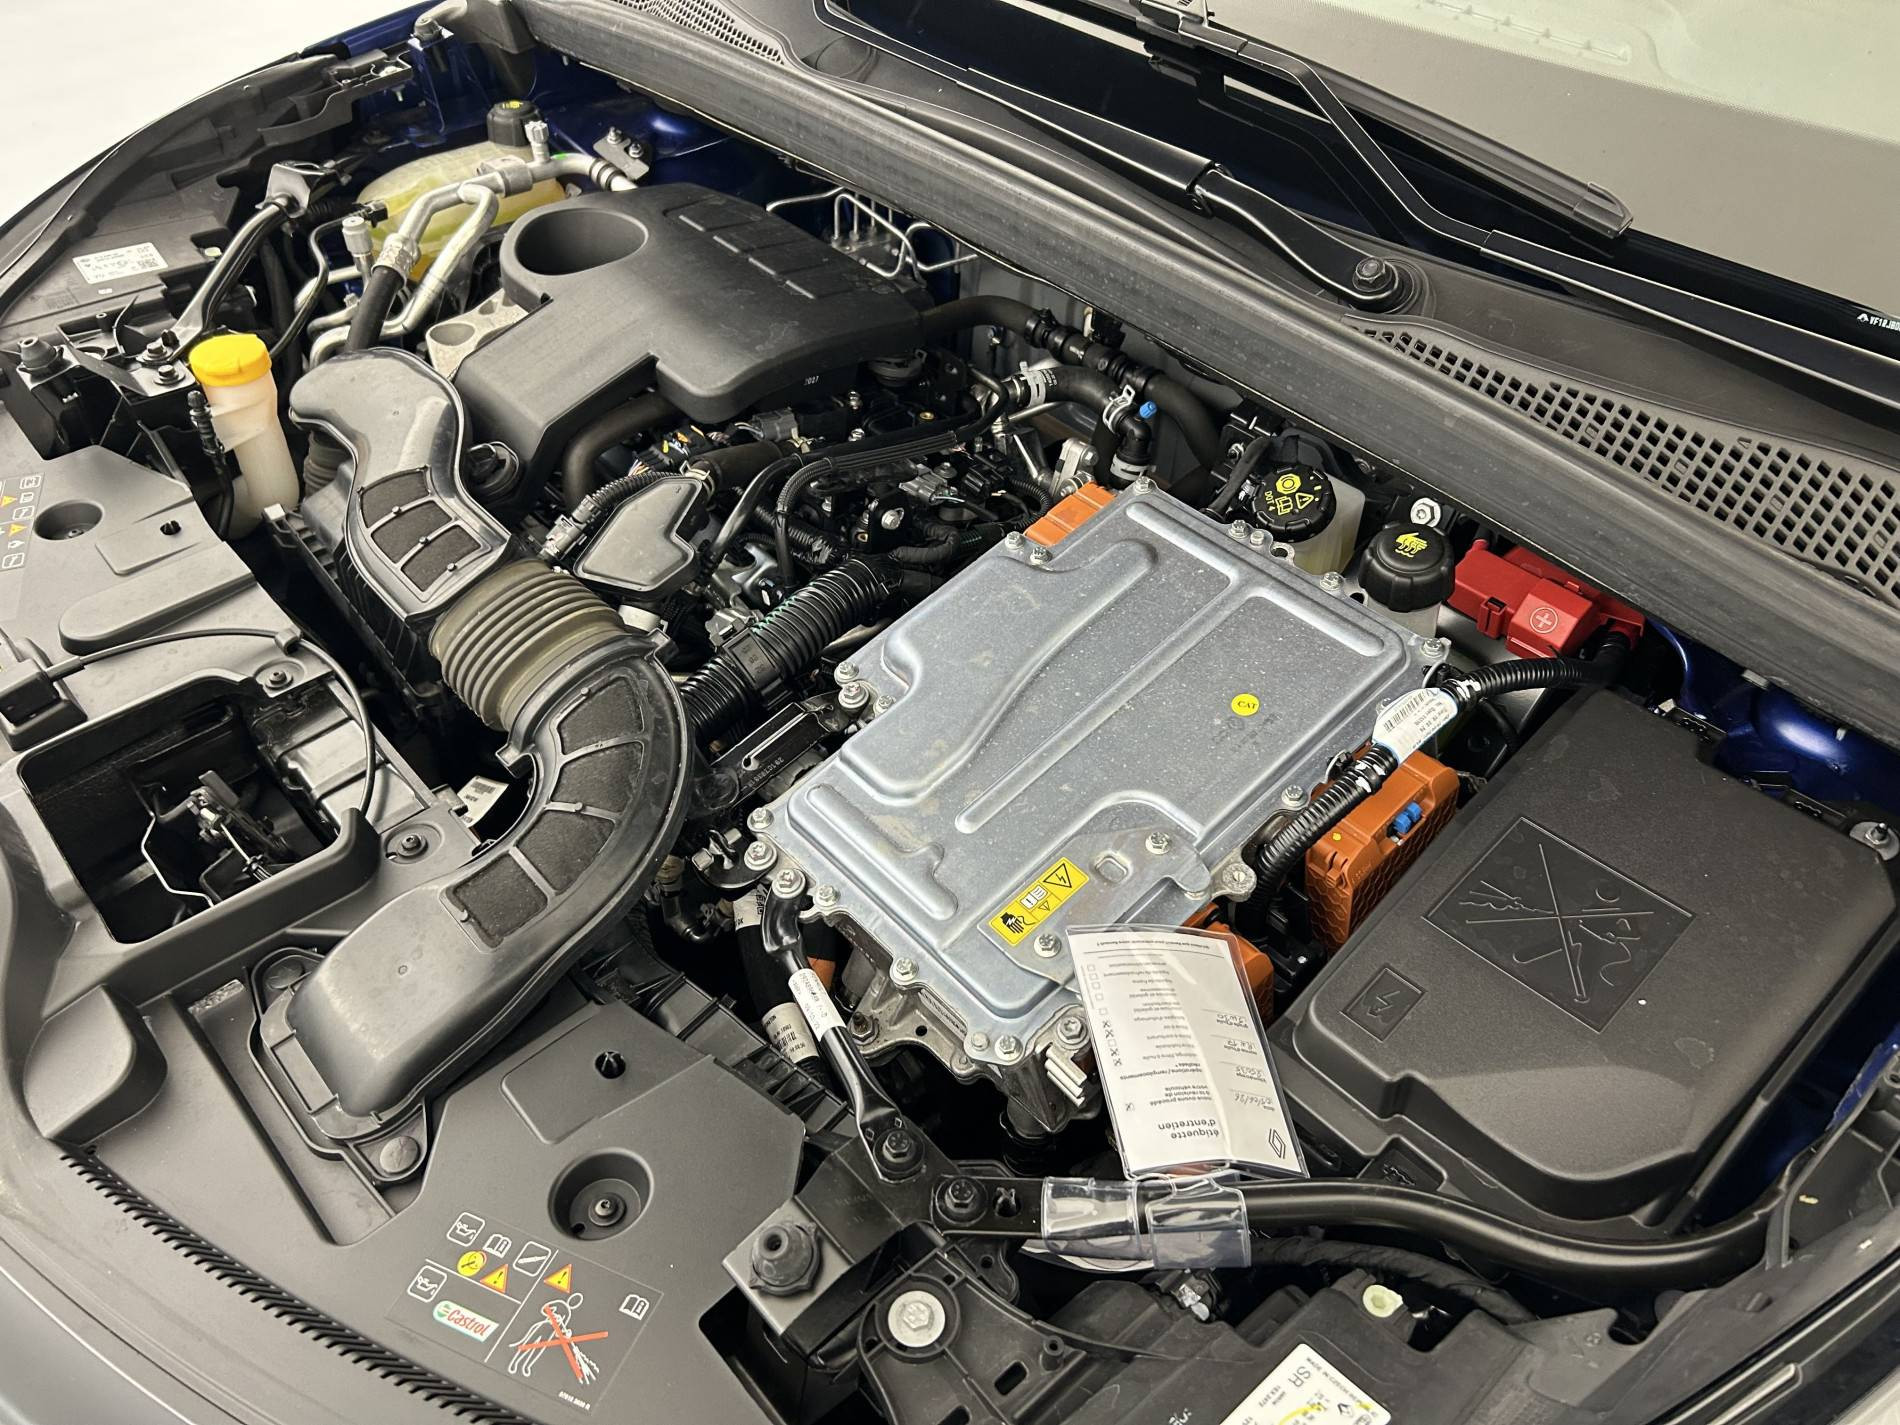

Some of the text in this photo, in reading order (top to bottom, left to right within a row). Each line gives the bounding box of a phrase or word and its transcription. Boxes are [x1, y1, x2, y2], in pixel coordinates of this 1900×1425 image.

[1264, 490, 1275, 504] DOT
[1158, 1119, 1216, 1130] d'entretien
[1170, 1128, 1220, 1139] étiquette
[446, 1309, 491, 1337] Castrol
[1288, 1366, 1312, 1388] SR
